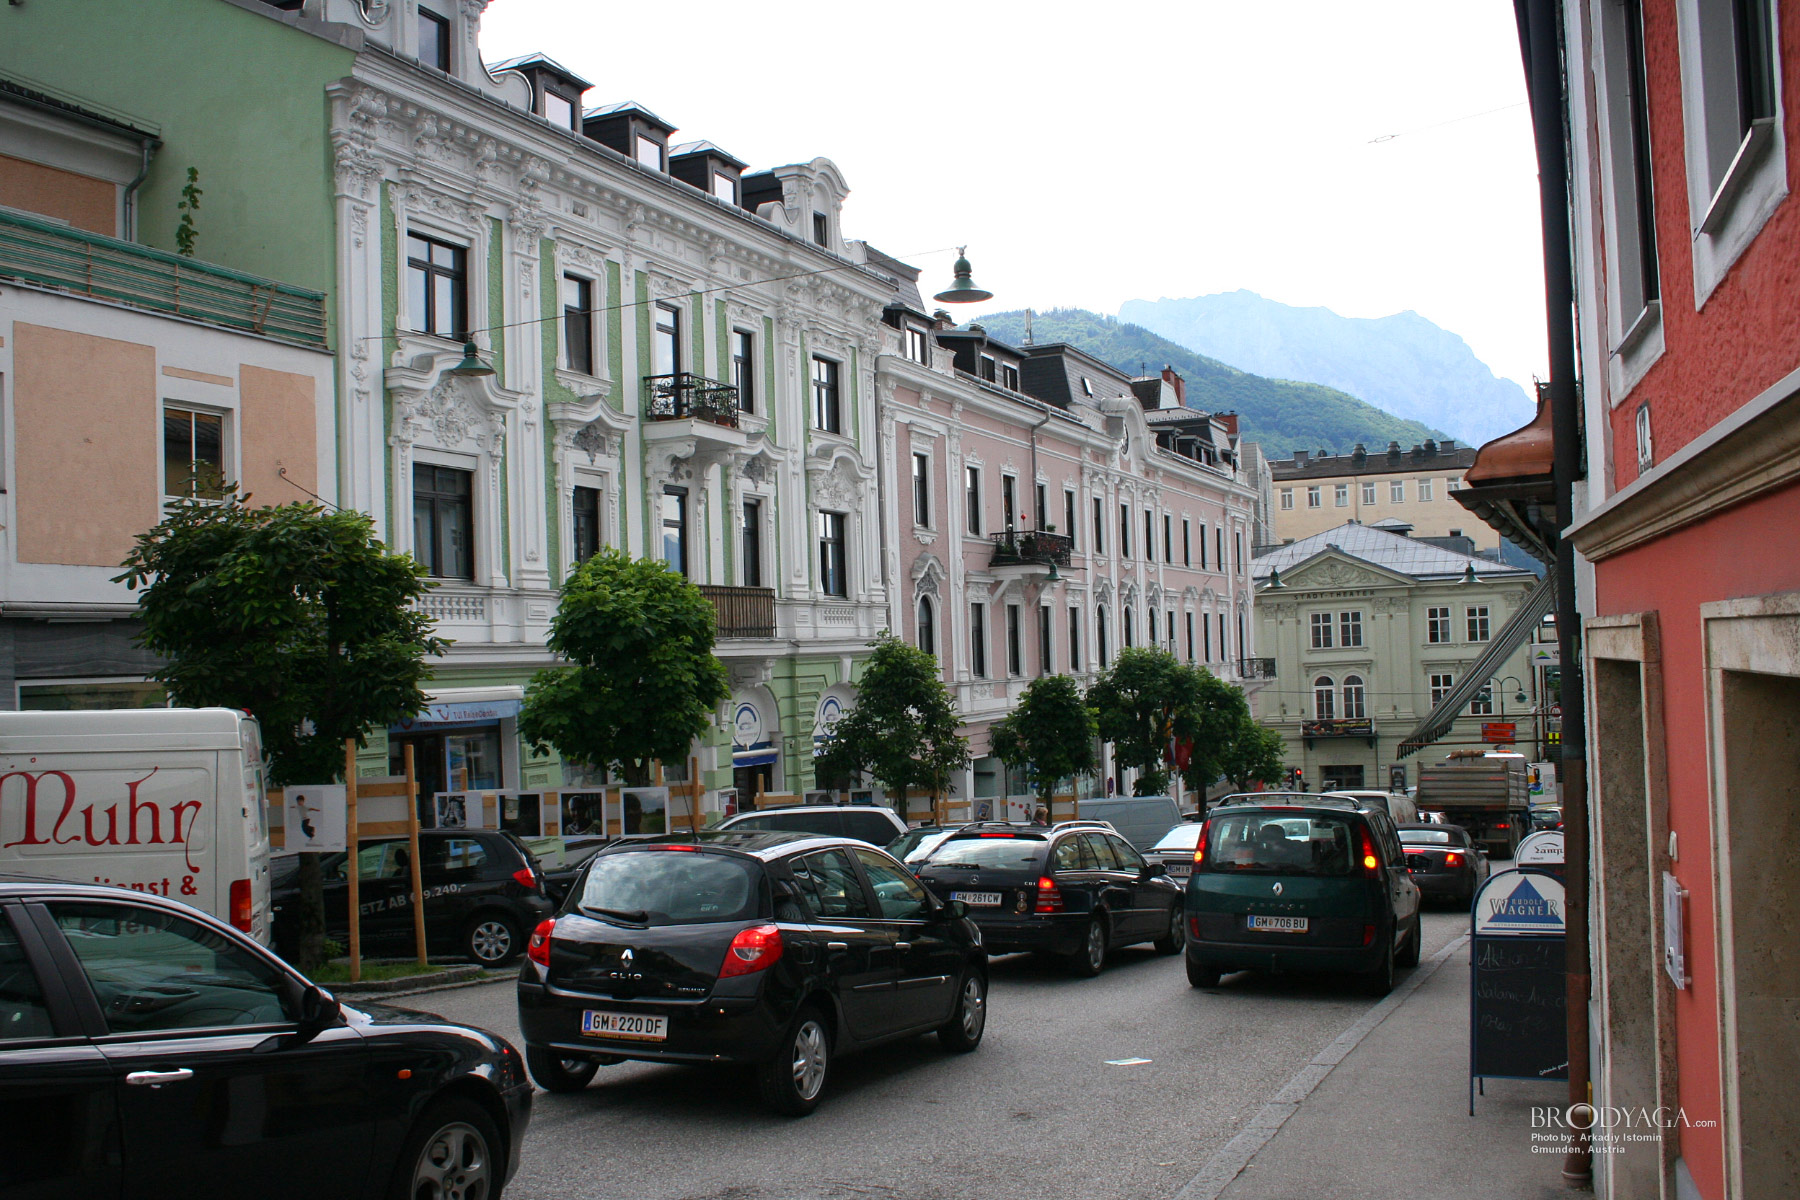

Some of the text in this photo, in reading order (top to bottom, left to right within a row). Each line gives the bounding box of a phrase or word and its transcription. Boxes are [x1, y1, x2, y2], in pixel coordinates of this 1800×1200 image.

[1294, 589, 1375, 600] STADT-THEATER
[180, 875, 198, 896] &
[389, 894, 406, 909] AB
[1489, 898, 1559, 916] WAGNER
[1255, 917, 1305, 929] GM 706 BU
[610, 972, 642, 980] CLIO
[593, 1014, 610, 1030] GM
[619, 1016, 643, 1033] 220
[646, 1018, 663, 1034] DF
